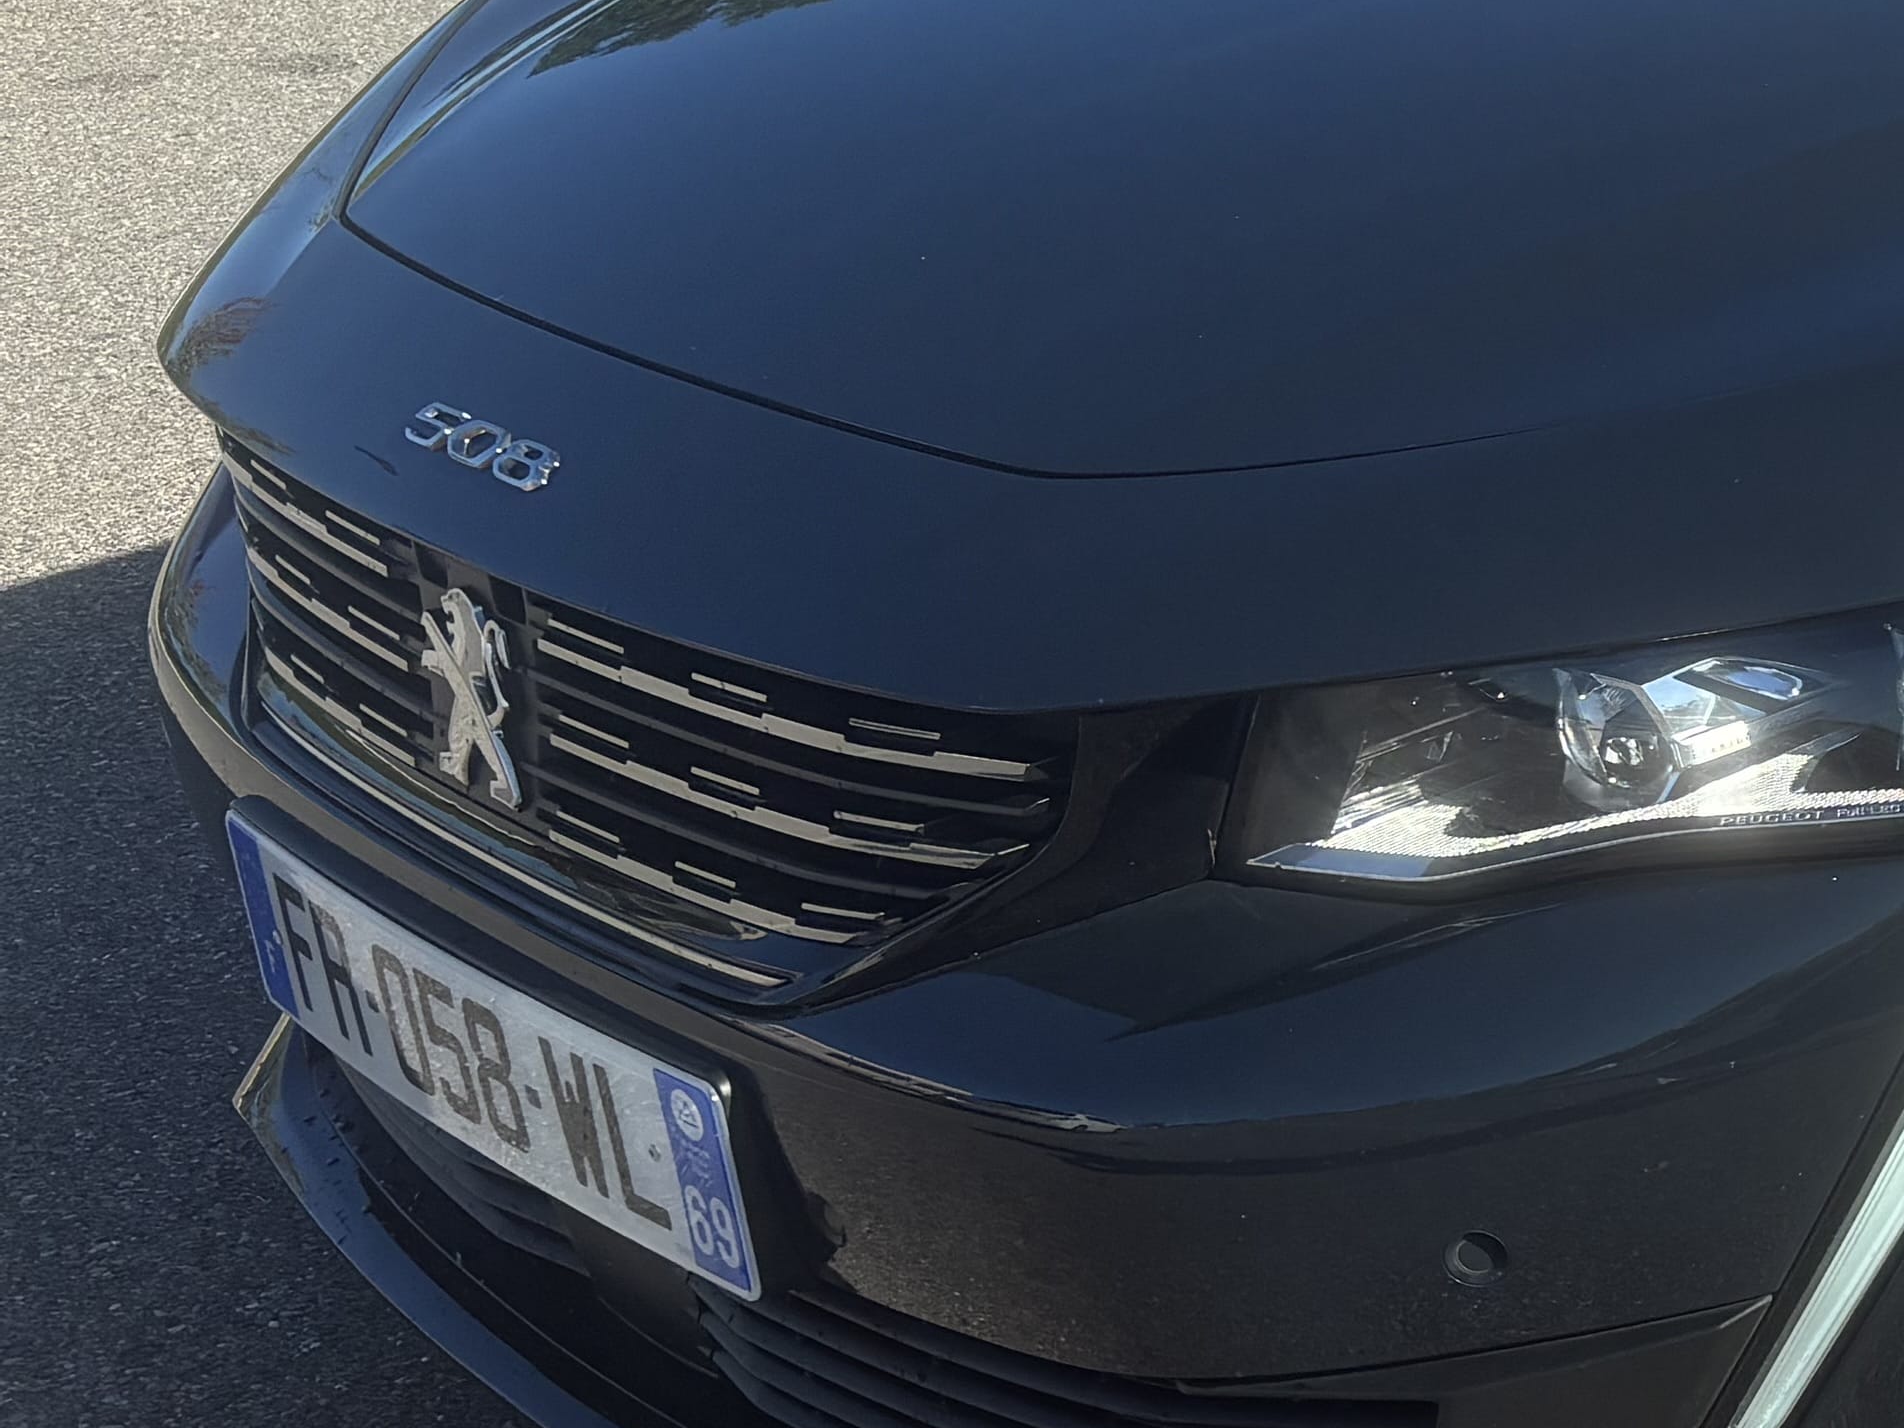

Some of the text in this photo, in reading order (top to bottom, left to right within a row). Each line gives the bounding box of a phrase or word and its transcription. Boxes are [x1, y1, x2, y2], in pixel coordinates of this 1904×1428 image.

[404, 401, 561, 493] 508
[1719, 810, 1825, 827] PEUGEOT
[271, 872, 673, 1232] FR-058-WL
[684, 1185, 741, 1269] 69
